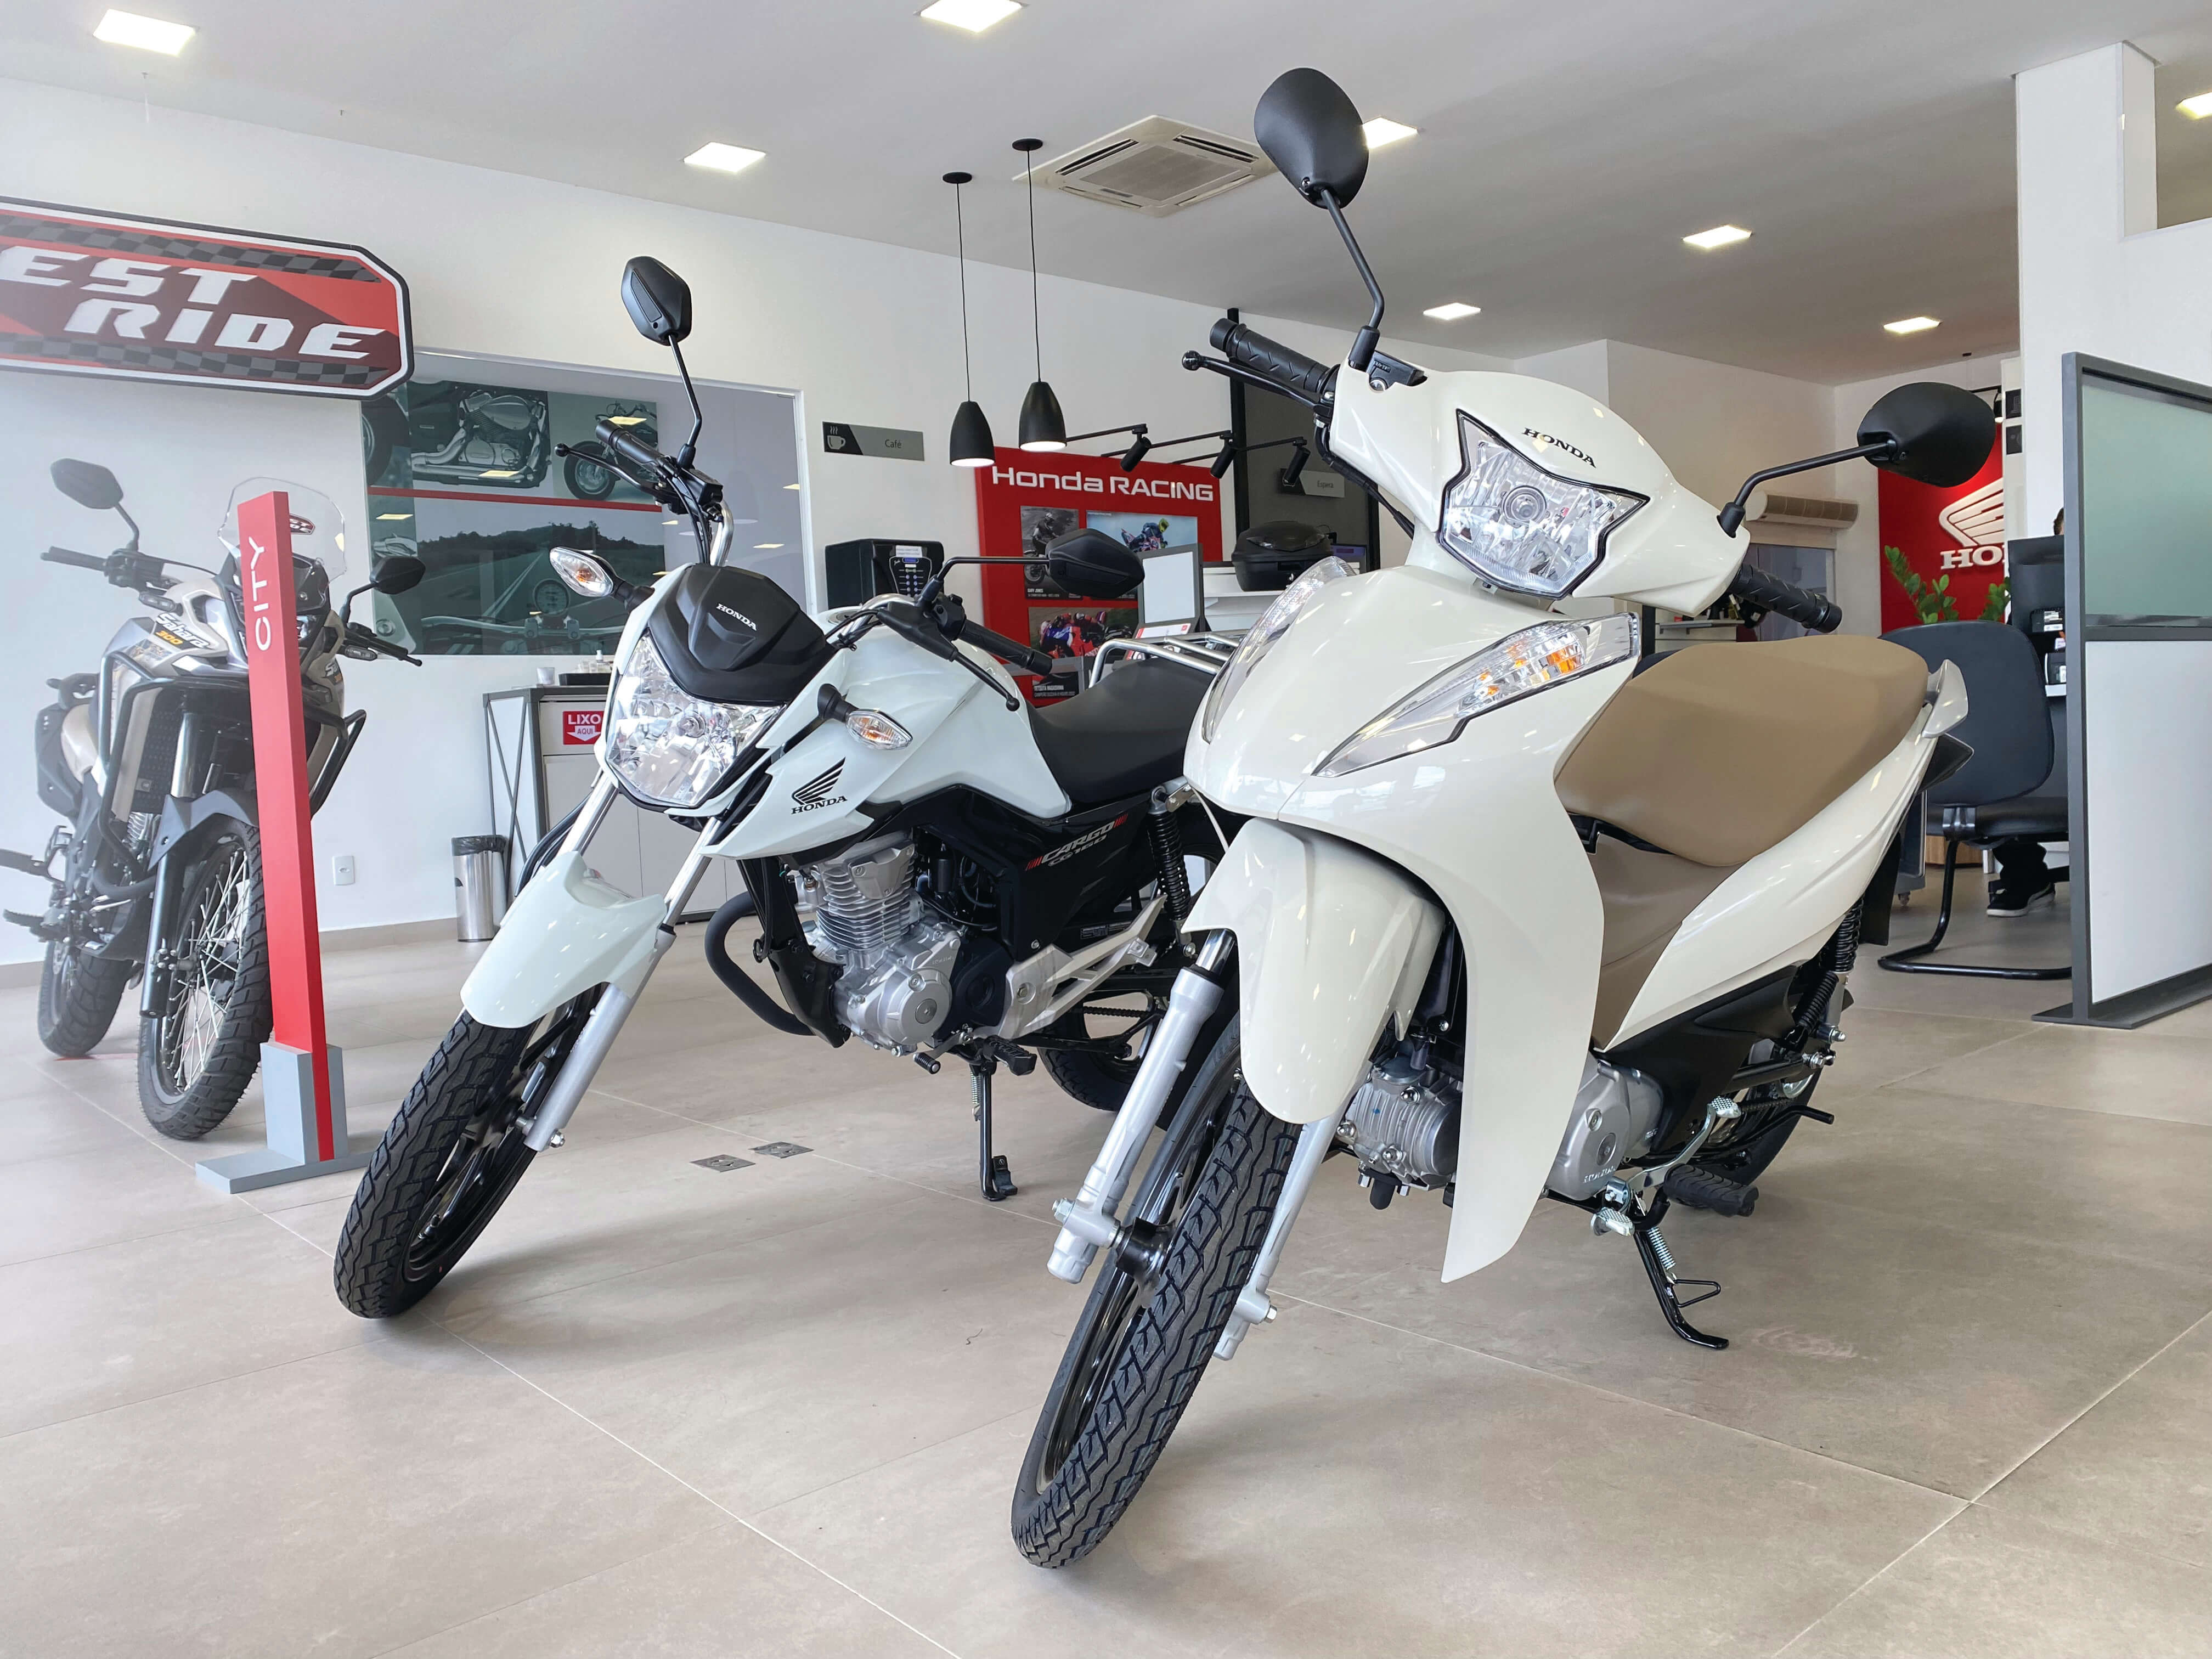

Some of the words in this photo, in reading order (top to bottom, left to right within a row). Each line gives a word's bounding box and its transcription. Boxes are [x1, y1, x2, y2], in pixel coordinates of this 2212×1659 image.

[64, 298, 386, 359] RIDE
[884, 437, 902, 450] Café
[1522, 427, 1597, 468] HONDA
[992, 466, 1104, 493] Honda
[1110, 475, 1214, 502] RACING
[1317, 480, 1334, 490] Espera
[1940, 545, 2002, 569] HO
[249, 537, 272, 651] CITY
[156, 612, 210, 649] Sahara
[716, 602, 758, 631] HONDA
[155, 630, 183, 646] 300
[568, 714, 601, 725] LIXO
[791, 795, 848, 815] HONDA
[1041, 821, 1115, 864] CARGO
